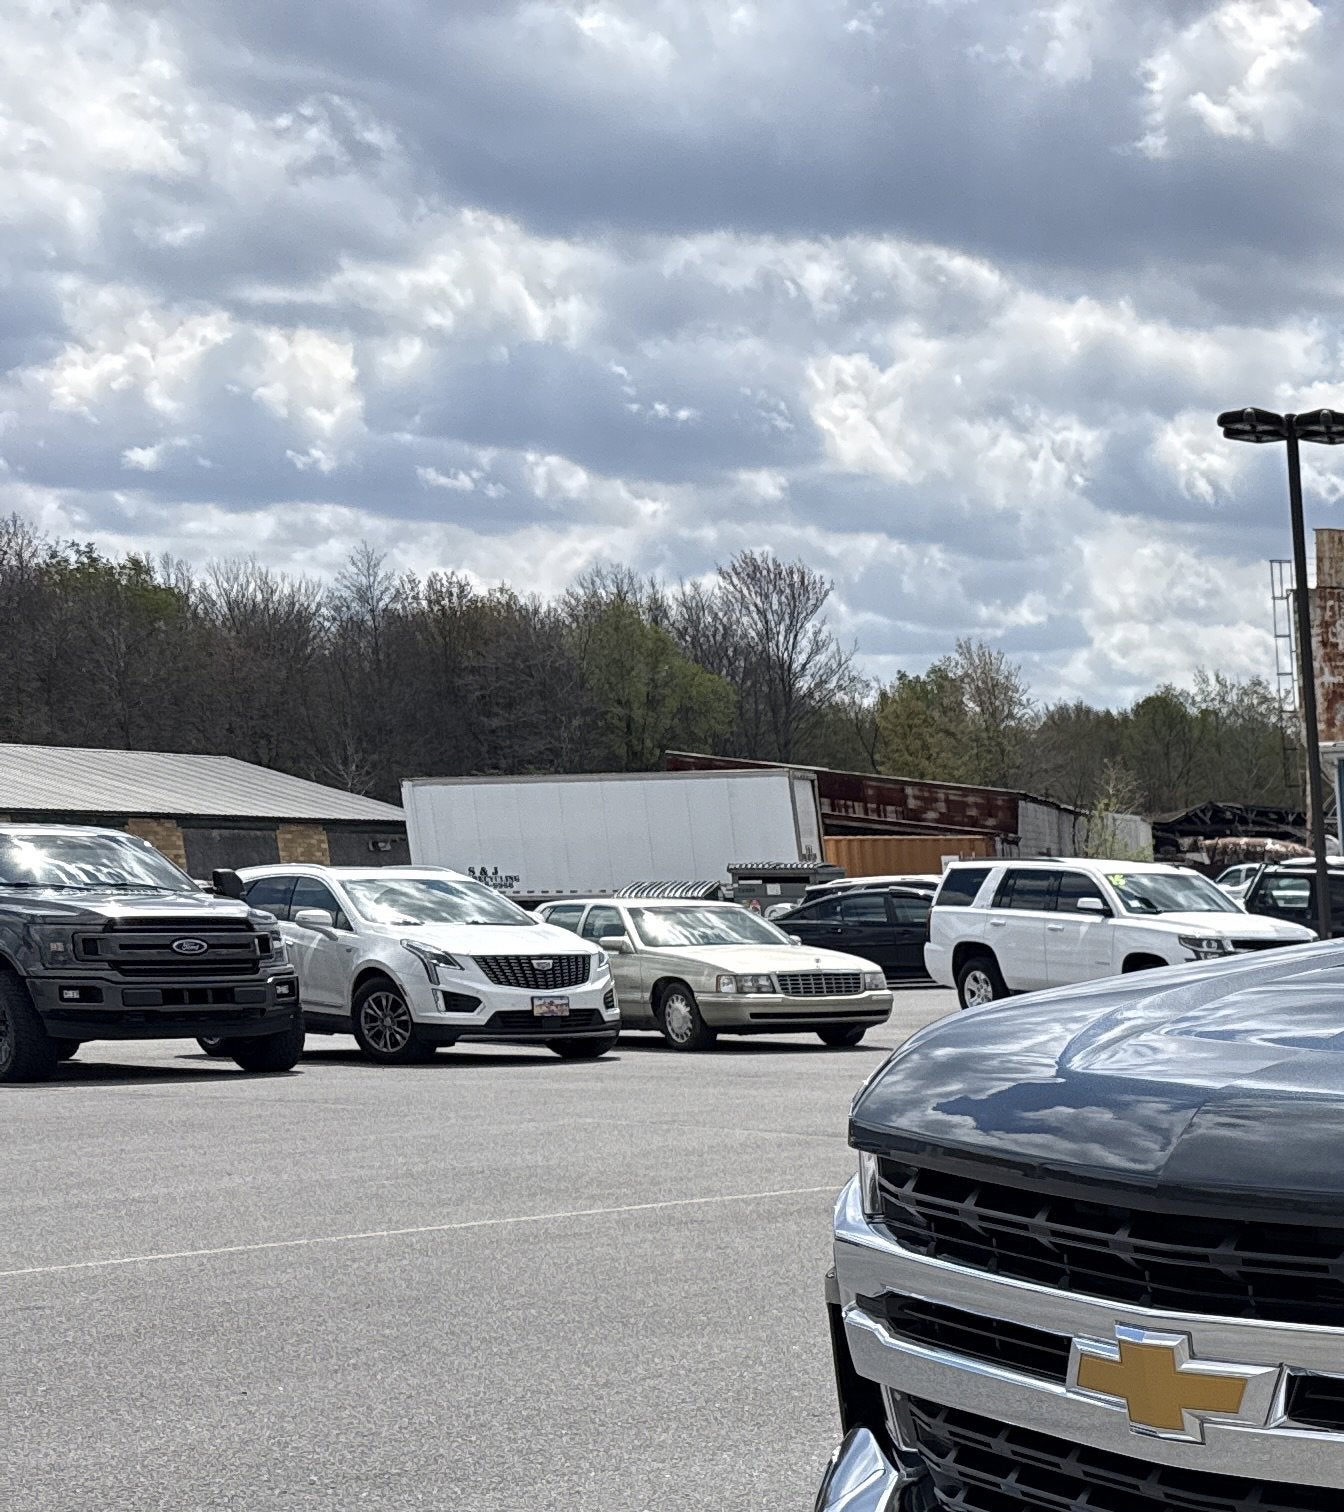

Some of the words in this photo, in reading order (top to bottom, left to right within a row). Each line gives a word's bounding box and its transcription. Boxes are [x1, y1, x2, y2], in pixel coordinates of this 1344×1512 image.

[467, 866, 476, 876] S
[480, 866, 488, 876] &
[492, 866, 499, 876] J
